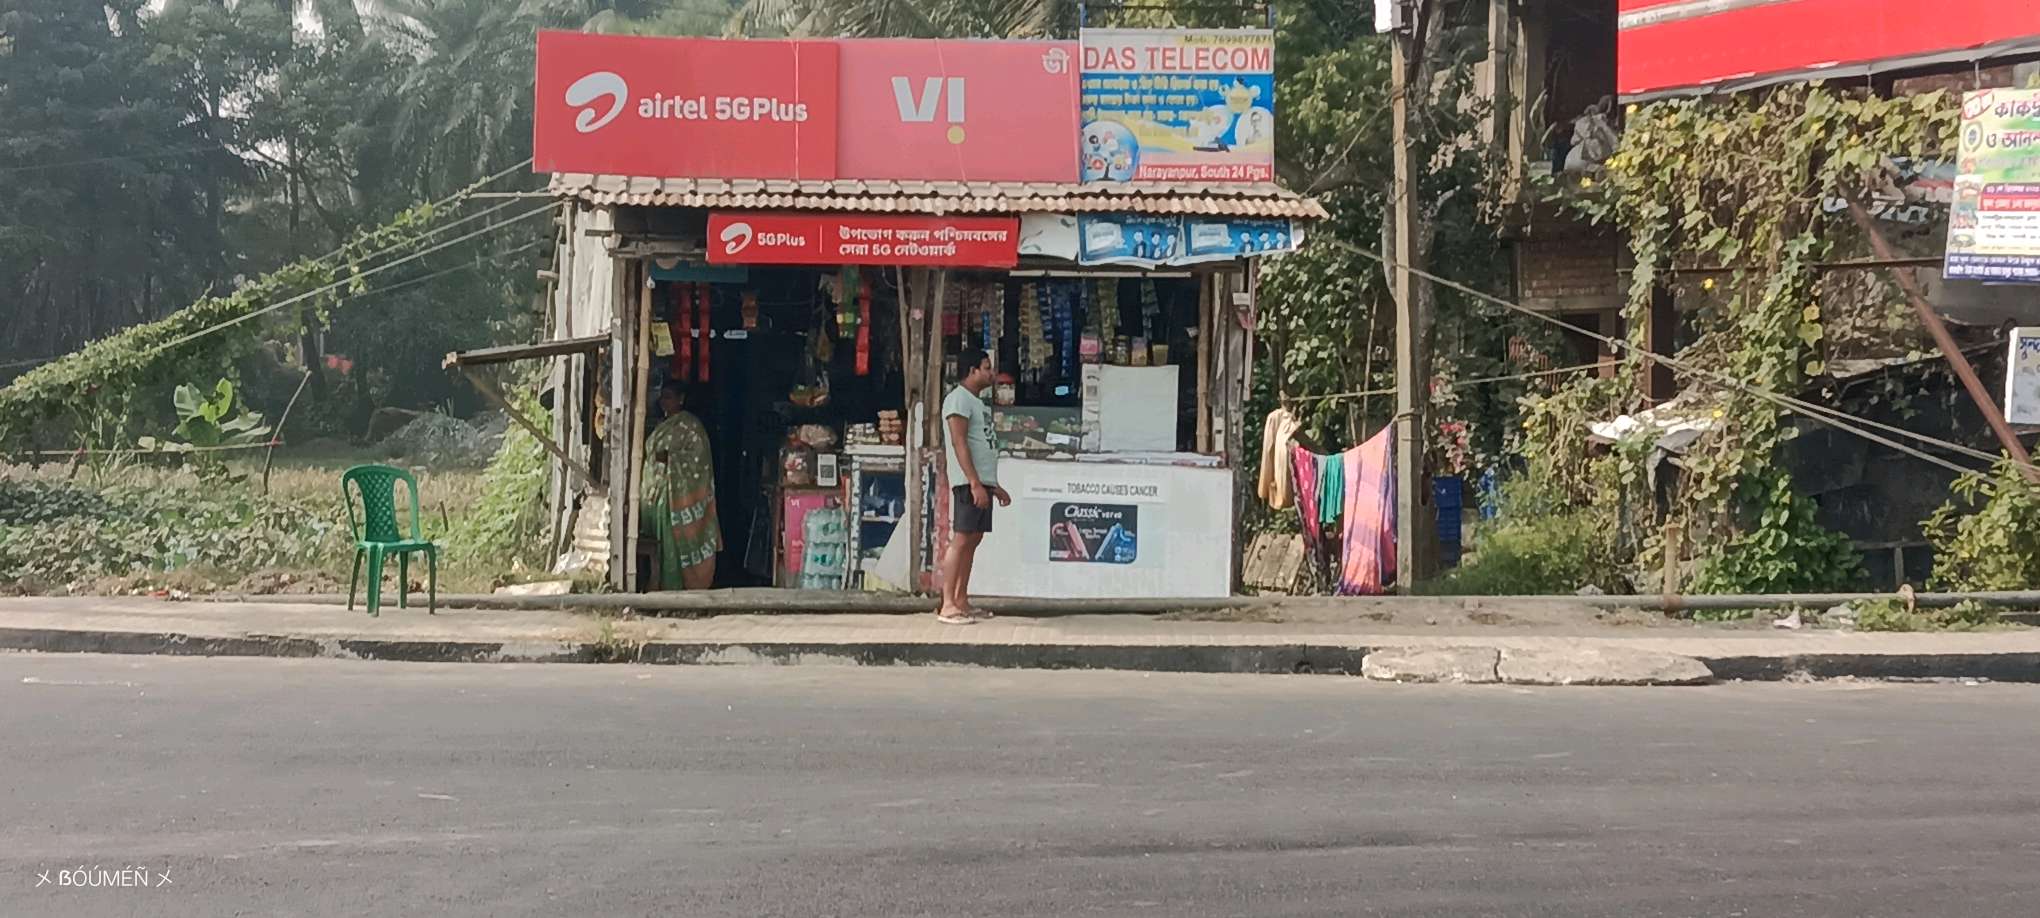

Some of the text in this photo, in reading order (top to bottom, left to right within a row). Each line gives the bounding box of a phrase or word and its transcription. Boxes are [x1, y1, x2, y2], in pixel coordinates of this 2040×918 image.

[1084, 47, 1270, 71] DAS TELECOM
[638, 92, 708, 119] airtel
[1986, 134, 1997, 148] ও
[1201, 165, 1230, 179] South
[1232, 166, 1244, 178] 24
[839, 225, 893, 241] উপভোগ
[839, 241, 956, 257] সেরা 5G নেটওয়ার্ক
[1067, 482, 1100, 494] TOBACCO
[1101, 483, 1128, 496] CAUSES
[1130, 485, 1158, 497] CANCER
